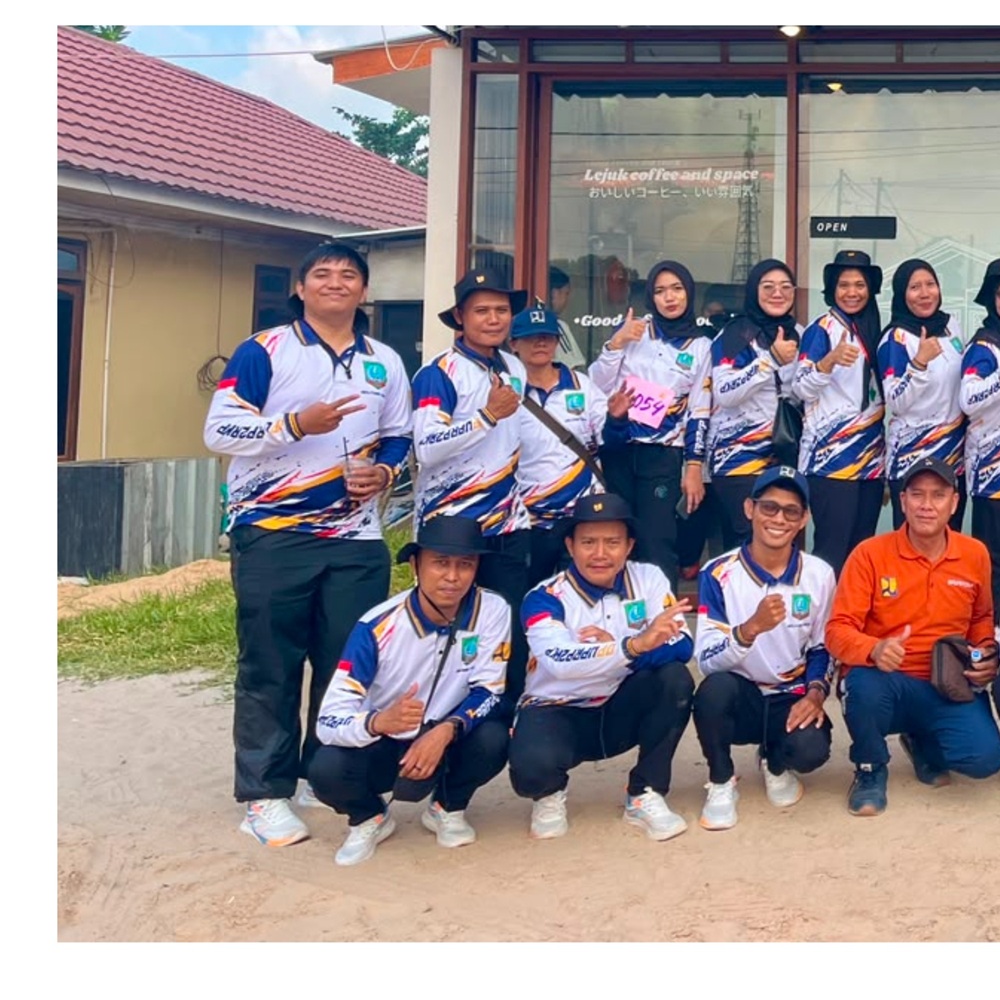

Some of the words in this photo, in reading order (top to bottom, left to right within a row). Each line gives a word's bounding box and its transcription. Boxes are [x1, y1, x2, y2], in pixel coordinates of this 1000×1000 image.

[629, 168, 680, 181] coffee
[680, 167, 713, 181] and
[713, 169, 760, 184] space
[816, 222, 848, 232] OPEN
[634, 393, 665, 416] 054
[216, 422, 272, 439] RP2RKP
